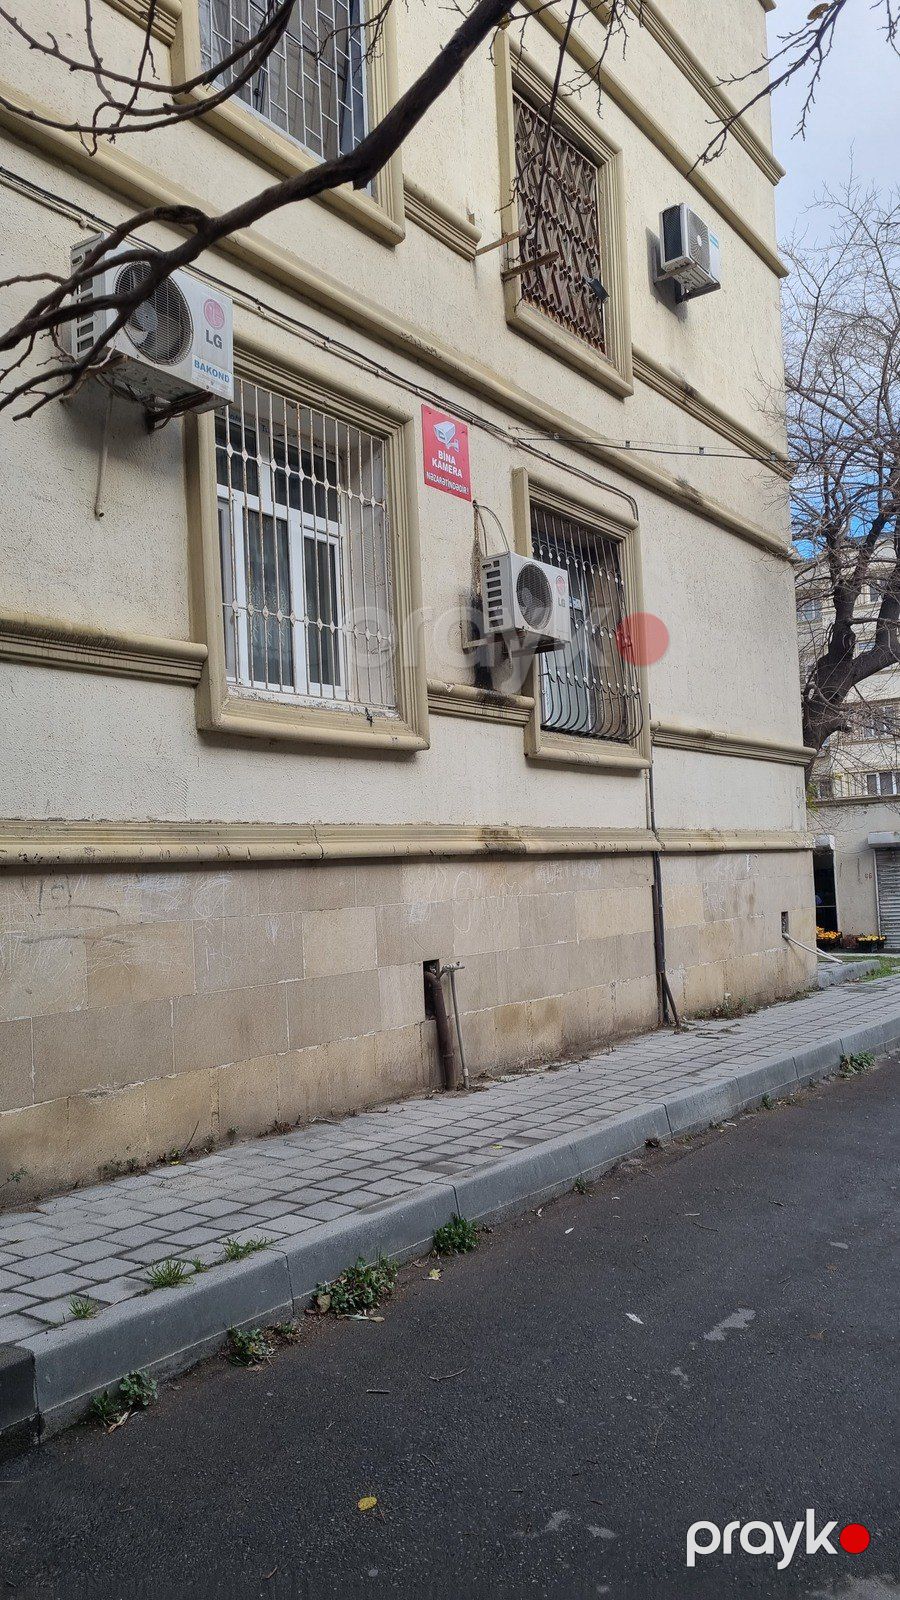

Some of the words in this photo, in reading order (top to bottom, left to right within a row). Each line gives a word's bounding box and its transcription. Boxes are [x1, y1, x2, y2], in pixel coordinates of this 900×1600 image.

[205, 329, 223, 350] LG
[194, 359, 230, 383] BAKOND
[431, 457, 463, 478] KAMERA
[557, 597, 566, 608] LG
